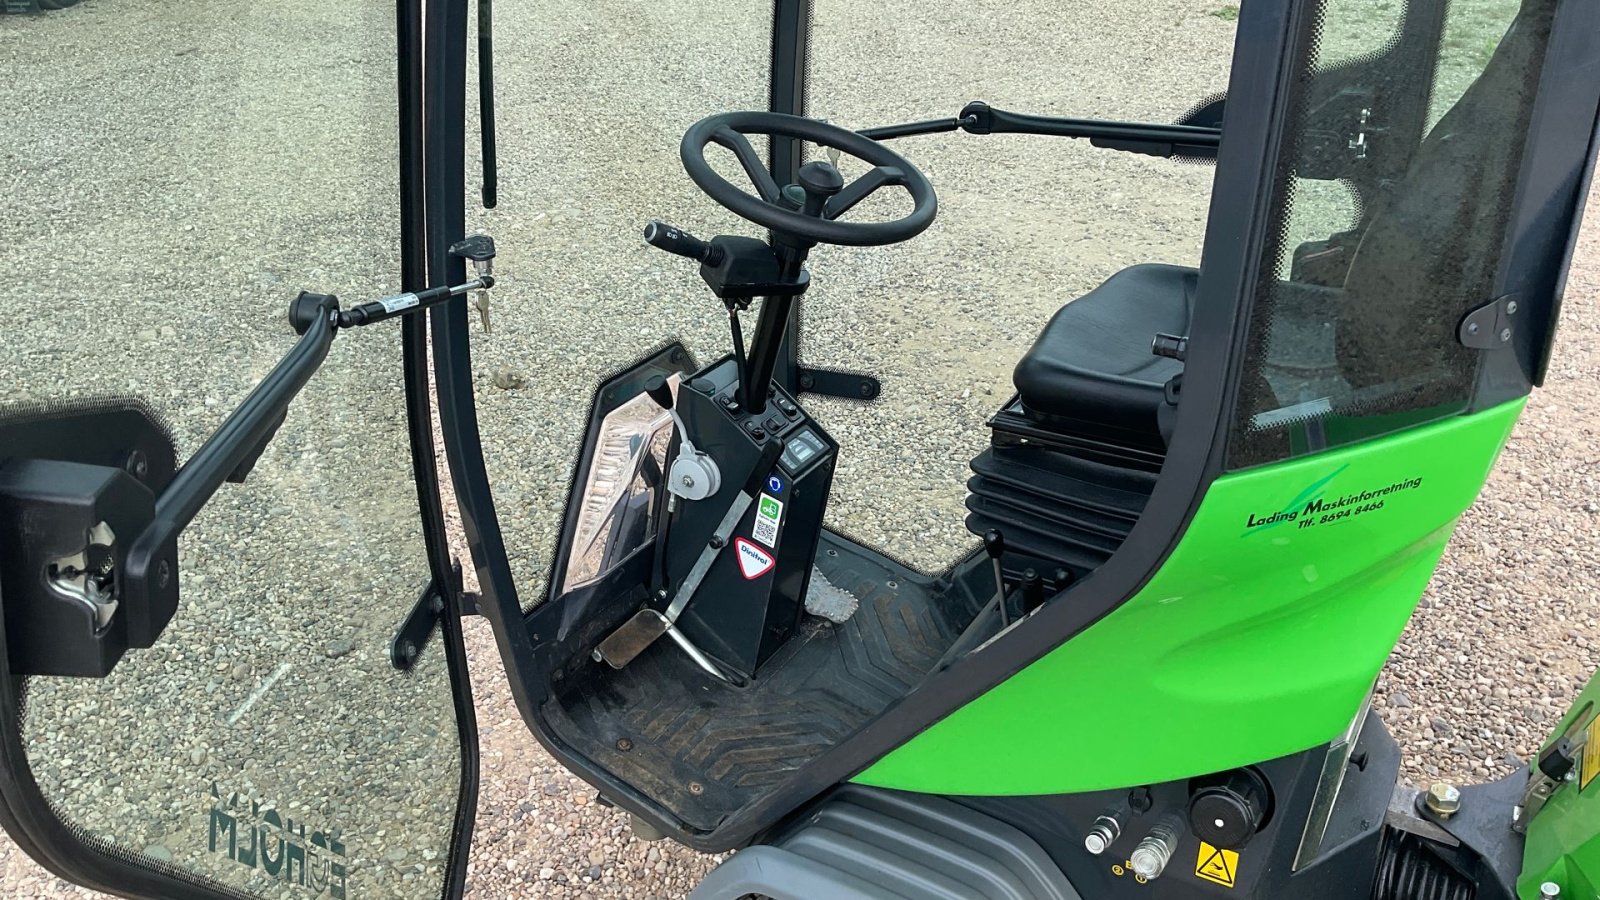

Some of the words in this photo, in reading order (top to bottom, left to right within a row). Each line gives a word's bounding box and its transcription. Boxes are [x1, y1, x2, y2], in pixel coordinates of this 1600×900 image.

[1246, 510, 1298, 528] Lading
[1302, 477, 1422, 516] Maskinforretning
[1298, 517, 1316, 530] Tlf.
[1319, 509, 1351, 524] 8694
[1354, 499, 1384, 515] 8466
[741, 545, 768, 565] Dinitrol
